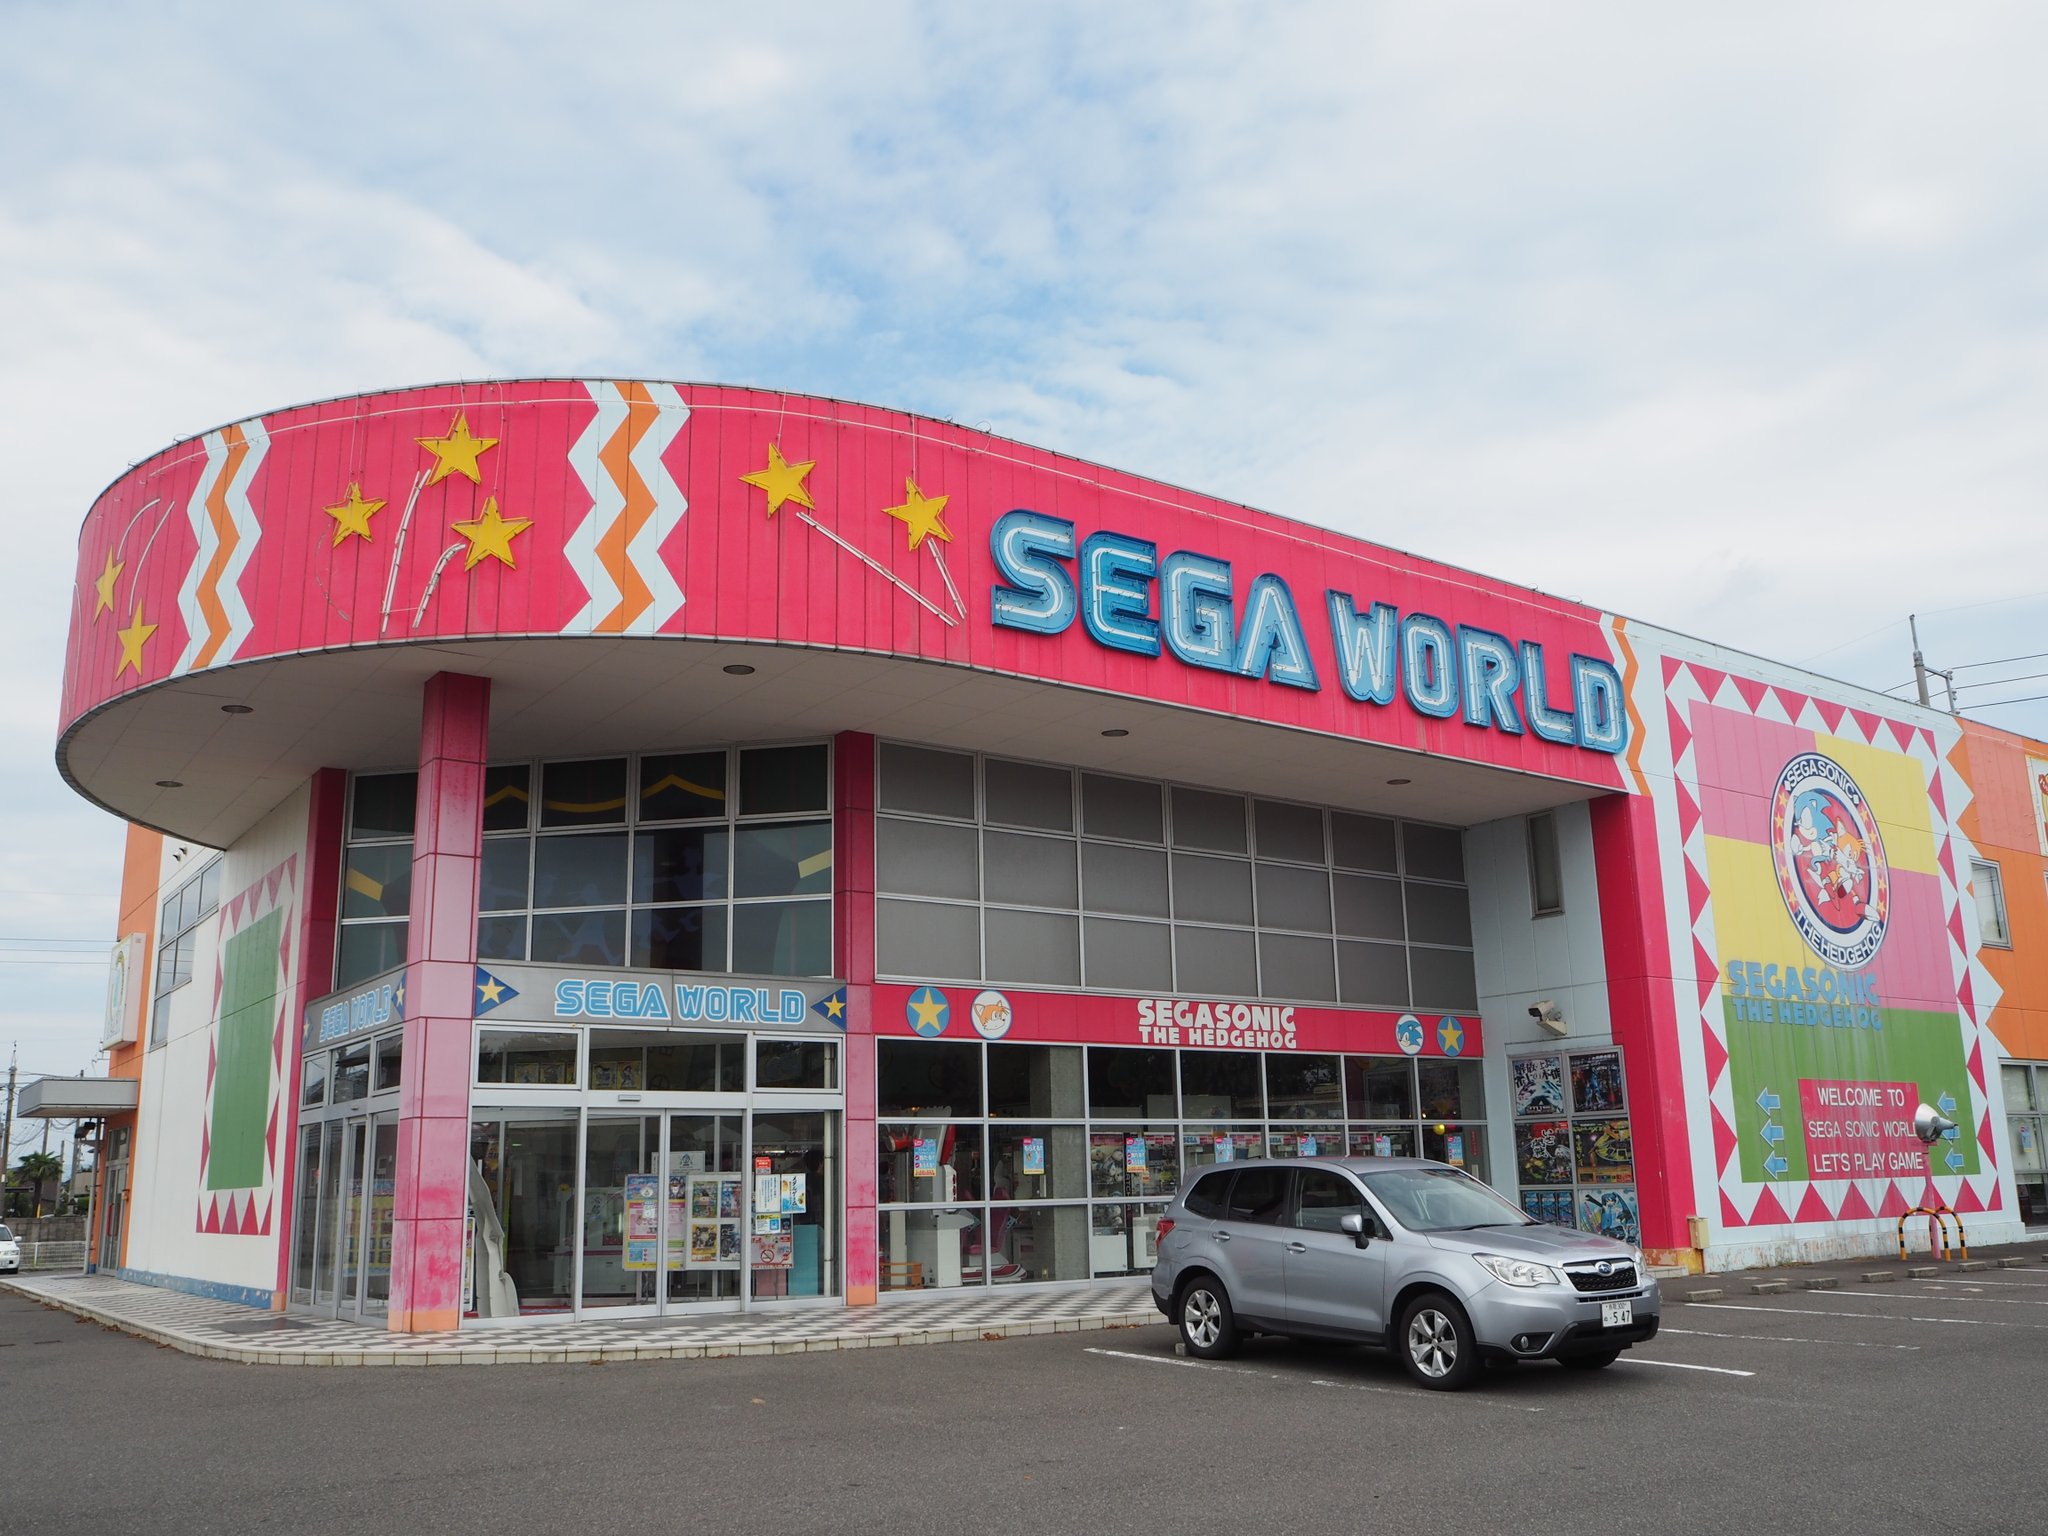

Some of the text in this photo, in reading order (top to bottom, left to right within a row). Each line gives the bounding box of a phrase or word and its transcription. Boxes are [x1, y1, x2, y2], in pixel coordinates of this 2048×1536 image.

[989, 508, 1627, 754] SEGA WORLD
[1797, 907, 1881, 964] THE HEDGEHOG
[1727, 959, 1880, 1006] SEGASONIC
[319, 985, 391, 1043] SEGA WORLD
[555, 979, 806, 1024] SEGA WORLD
[1137, 1000, 1296, 1031] SEGASONIC
[1733, 997, 1883, 1031] THE HEDGEHOG
[1139, 1026, 1296, 1049] THE HEDGEHOG
[1817, 1087, 1905, 1107] WELCOME TO
[1808, 1120, 1841, 1138] SEGA
[1845, 1120, 1880, 1137] SONIC
[1813, 1152, 1924, 1173] LET'S PLAY GAME
